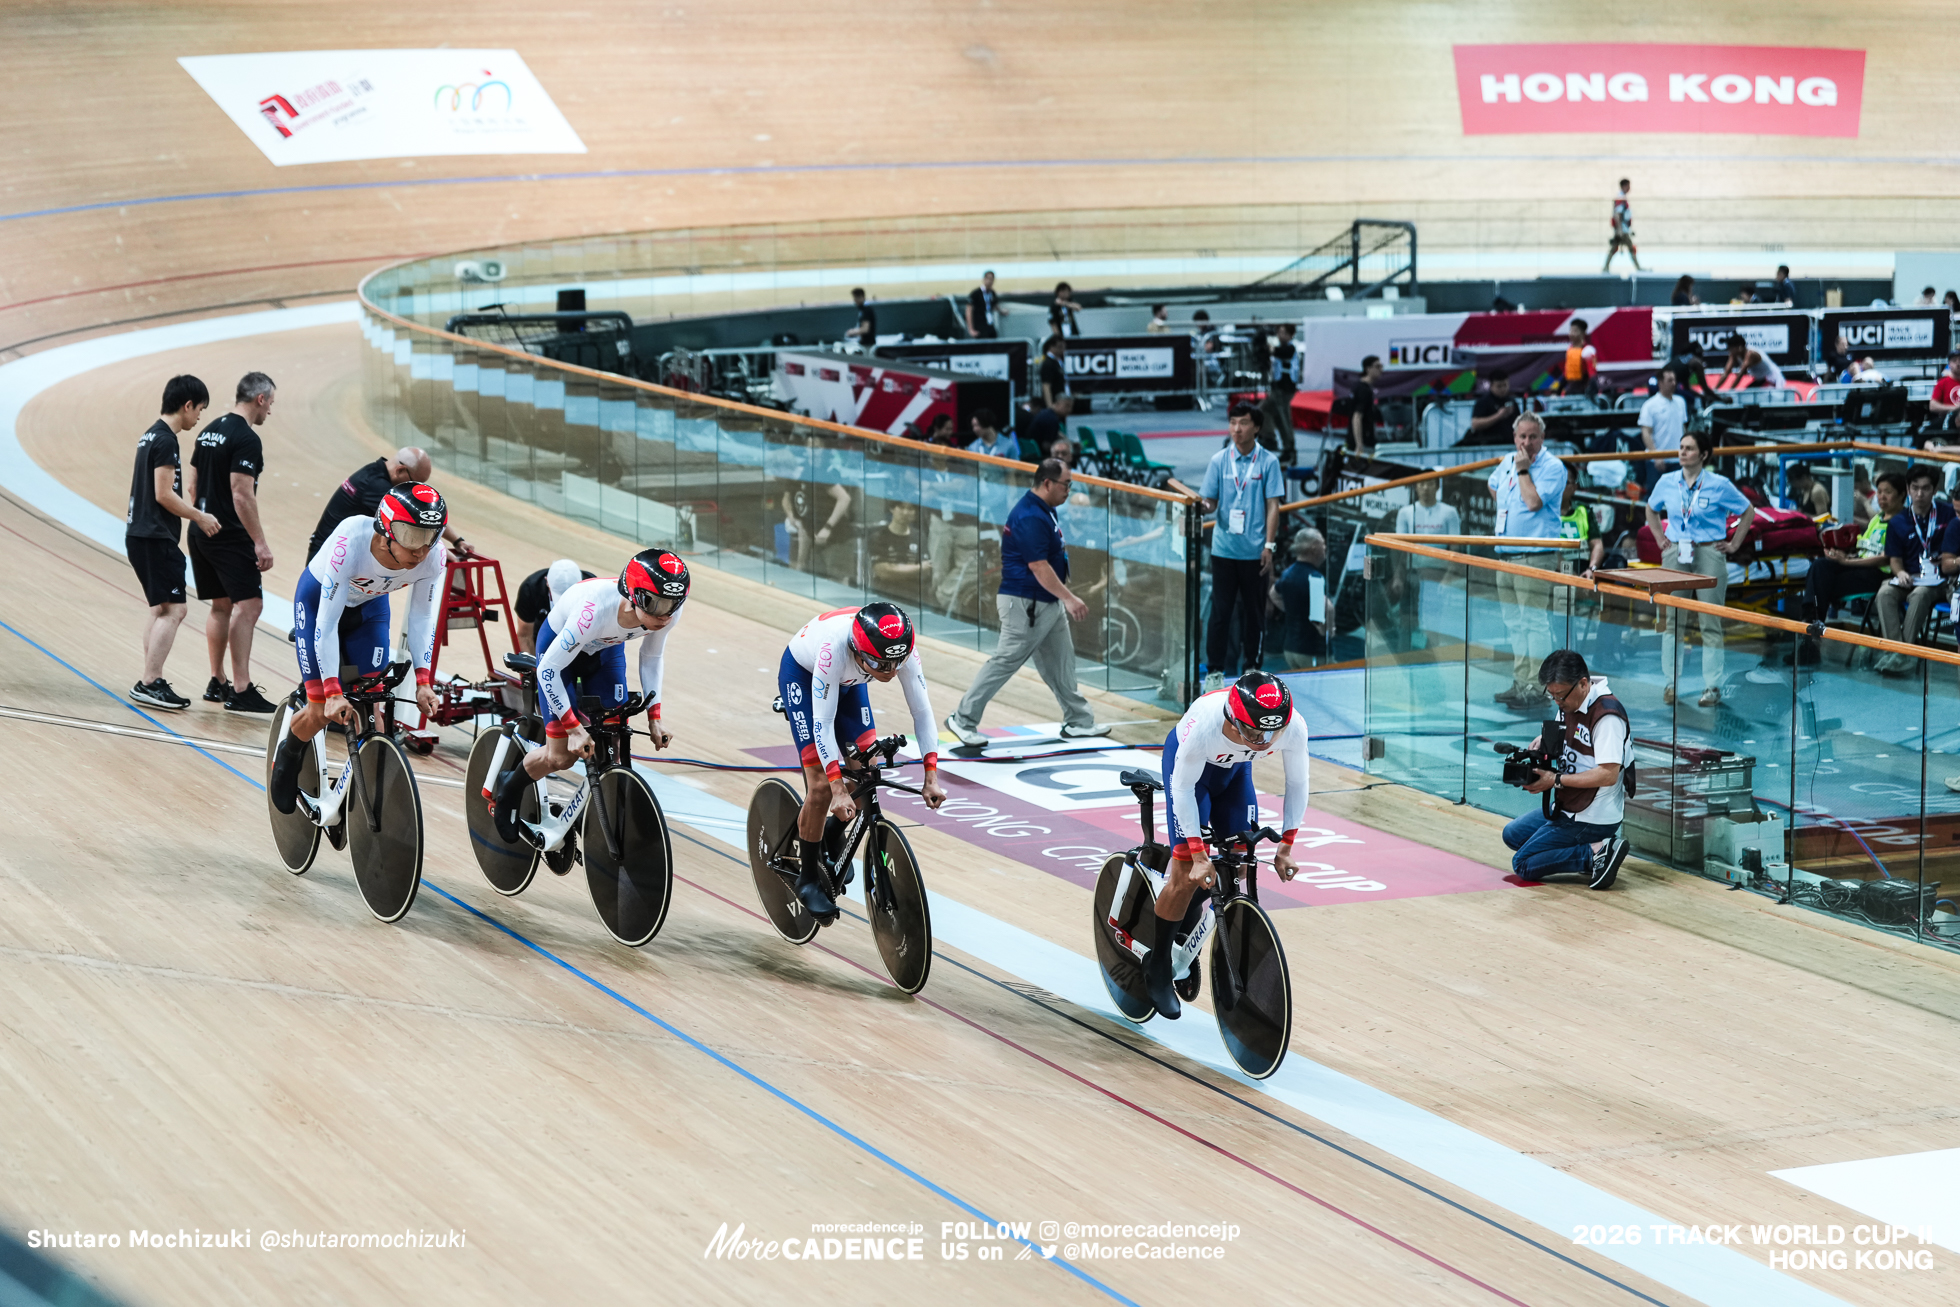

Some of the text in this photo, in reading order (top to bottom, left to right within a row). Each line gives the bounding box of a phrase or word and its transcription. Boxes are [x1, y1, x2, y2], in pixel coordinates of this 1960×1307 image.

[1480, 72, 1838, 107] HONG KONG
[1847, 325, 1883, 346] UCI
[1074, 354, 1114, 374] UCI
[1401, 344, 1449, 365] UCI
[792, 710, 811, 740] SPEED
[560, 781, 586, 823] TORAY
[834, 809, 865, 876] BRIDGESTONE
[1184, 912, 1208, 953] TORAY
